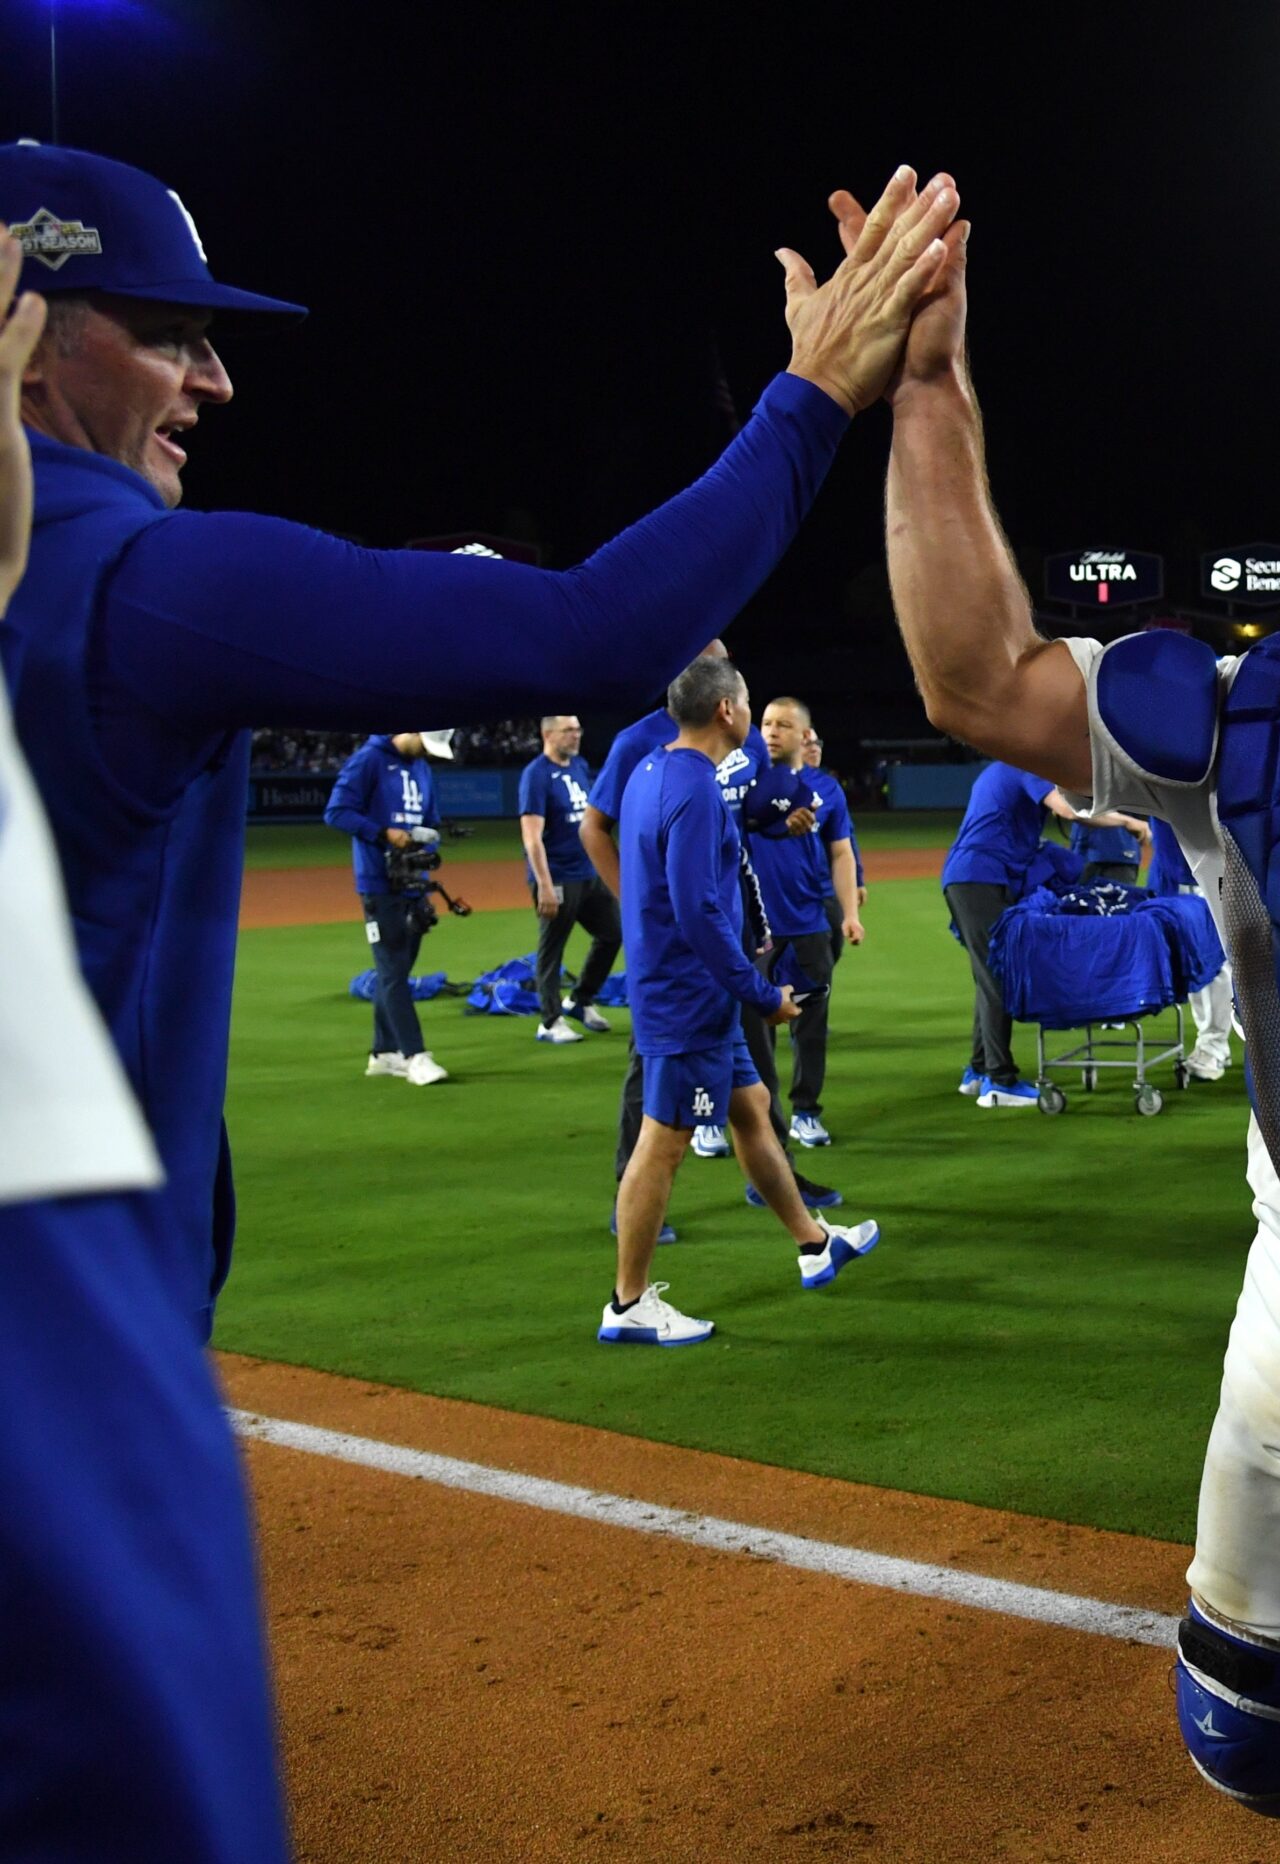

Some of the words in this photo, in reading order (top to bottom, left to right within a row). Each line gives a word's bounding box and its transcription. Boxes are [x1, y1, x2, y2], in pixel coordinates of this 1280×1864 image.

[1069, 564, 1138, 582] ULTRA
[400, 769, 424, 812] LA
[561, 774, 588, 810] LA
[692, 1087, 714, 1116] LA
